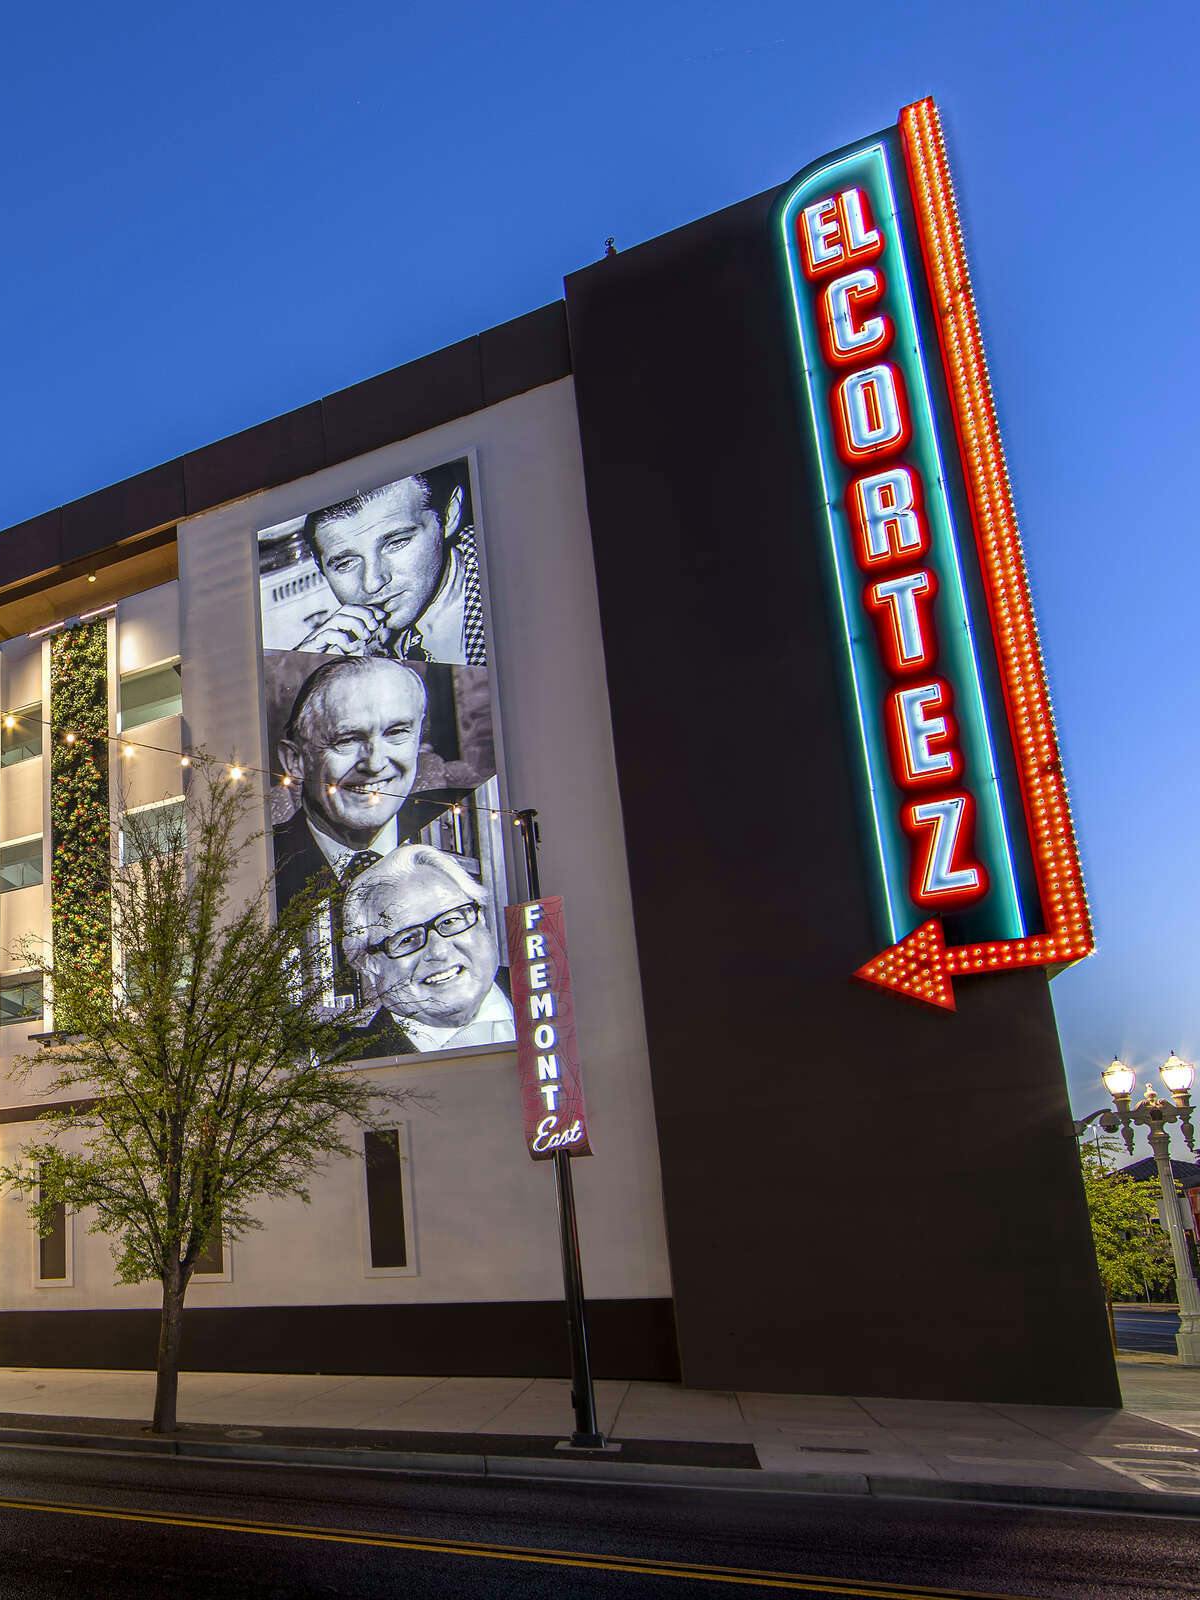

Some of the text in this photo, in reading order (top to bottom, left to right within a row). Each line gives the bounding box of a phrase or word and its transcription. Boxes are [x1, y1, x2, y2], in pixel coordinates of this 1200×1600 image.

[801, 187, 880, 272] EL
[824, 268, 980, 897] CORTEZ
[523, 903, 560, 1111] FREMONT
[531, 1115, 583, 1152] East
